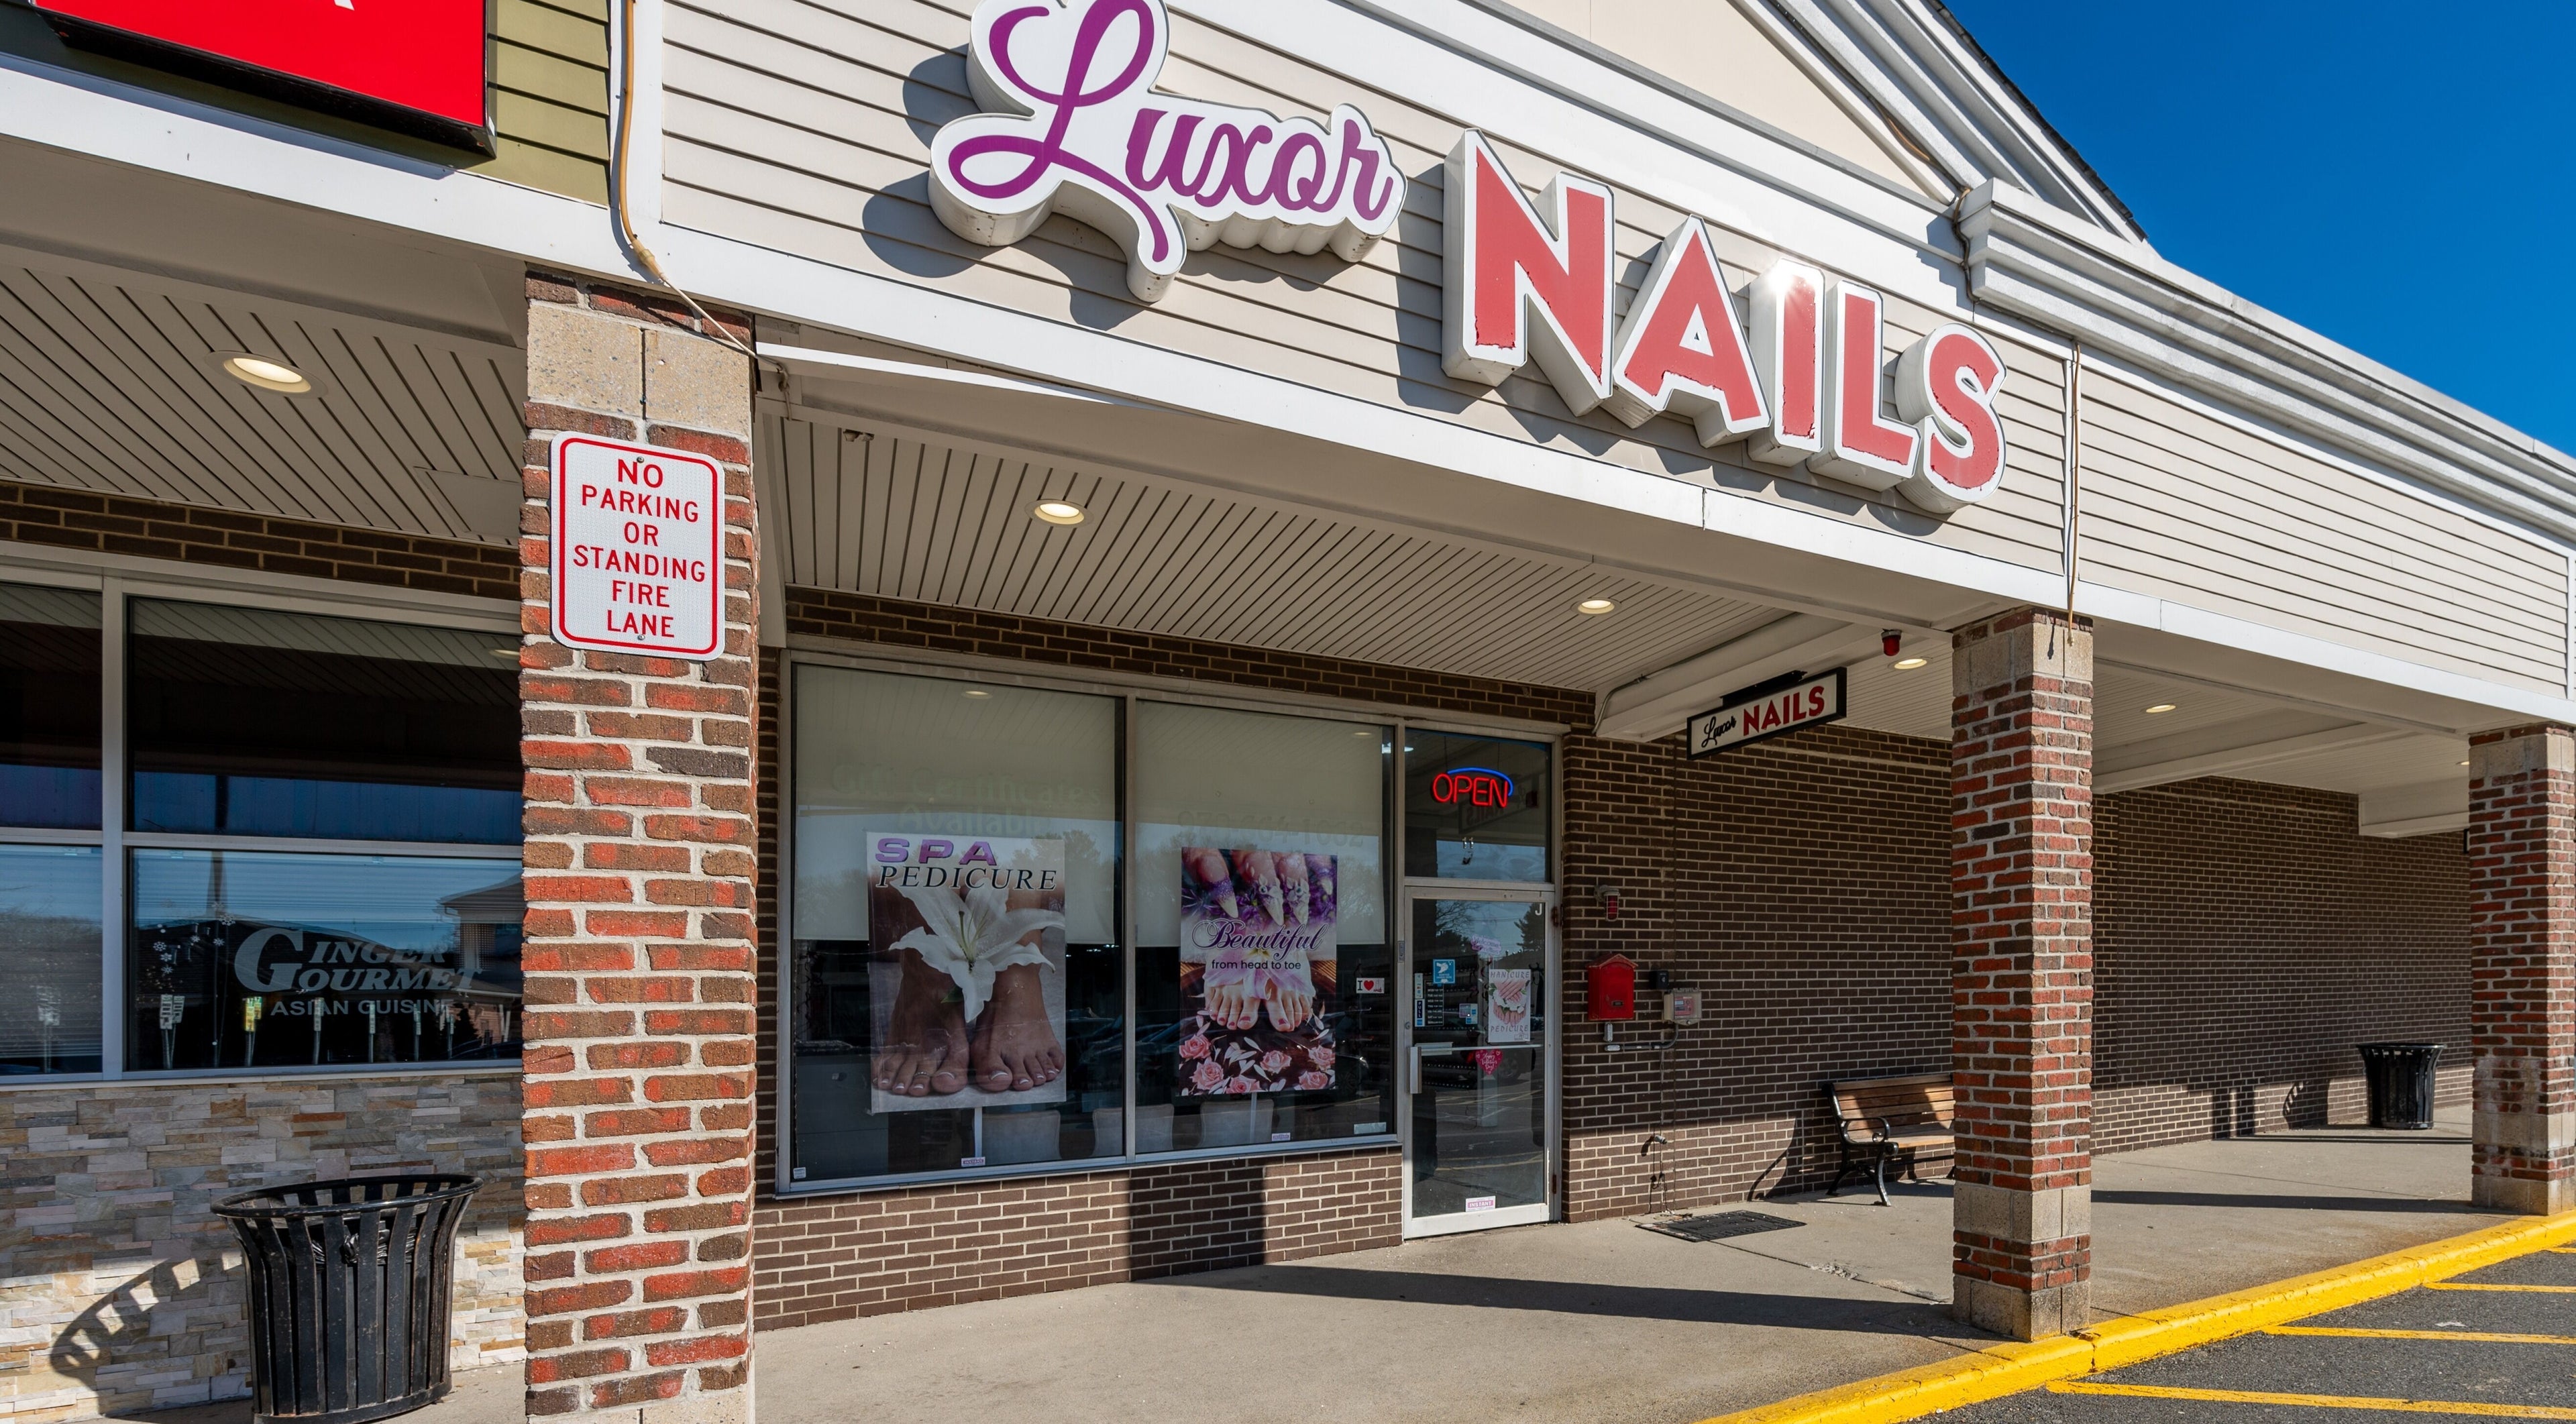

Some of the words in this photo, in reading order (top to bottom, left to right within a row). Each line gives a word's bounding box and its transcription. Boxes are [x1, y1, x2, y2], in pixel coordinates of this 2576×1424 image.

[948, 0, 1394, 262] Luxor
[1473, 142, 2002, 491] NAILS
[617, 458, 663, 488] NO
[582, 484, 698, 523] PARKING
[624, 521, 658, 547] OR
[573, 544, 705, 582] STANDING
[612, 580, 669, 608] FIRE
[607, 609, 675, 638] LANE
[1701, 716, 1737, 747] Luxor
[1743, 686, 1825, 736] NAILS
[1432, 773, 1509, 808] OPEN
[875, 838, 997, 866] SPA
[876, 865, 1057, 891] PEDICURE
[1192, 918, 1328, 961] Beautiful
[234, 927, 446, 992] GINGER
[1212, 960, 1238, 969] from
[1241, 960, 1268, 969] head
[1271, 960, 1282, 969] to
[1285, 960, 1301, 969] toe
[1490, 971, 1530, 979] MANICURE
[270, 1000, 349, 1016] ASIAN
[1491, 1025, 1529, 1033] PEDICURE
